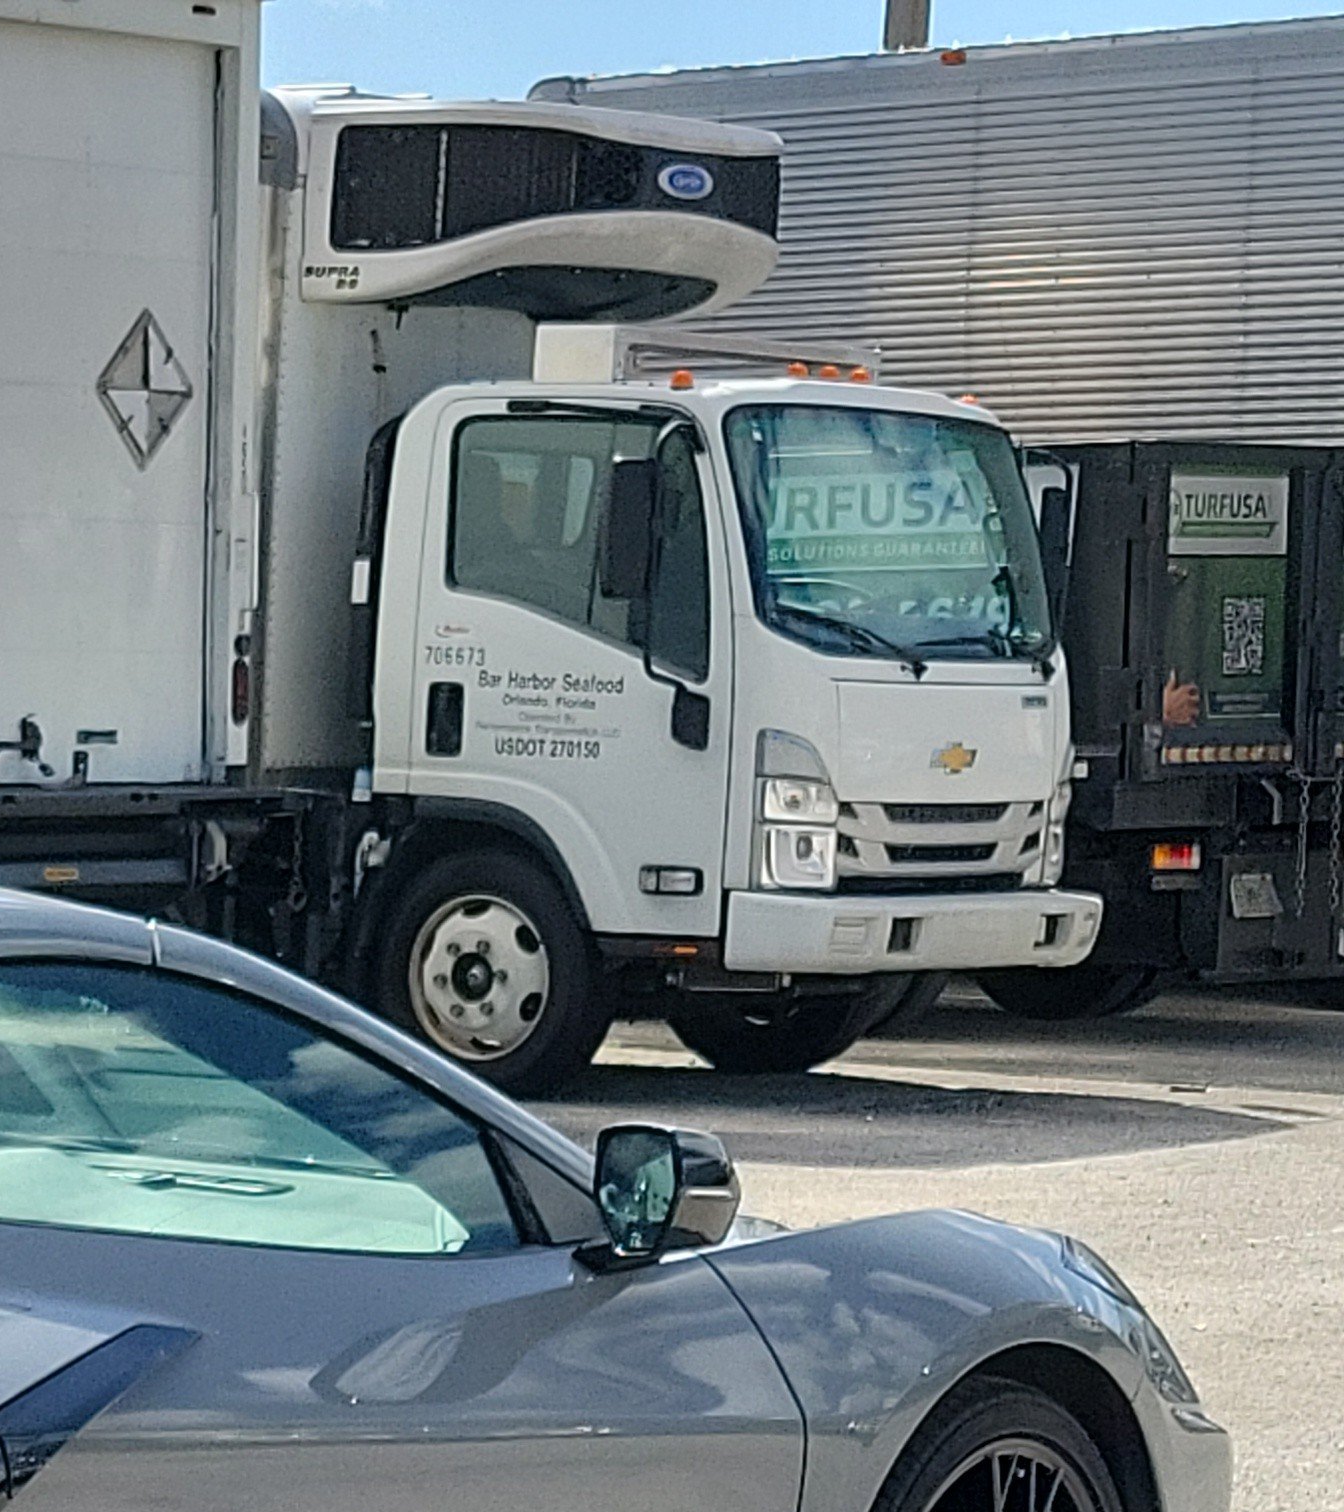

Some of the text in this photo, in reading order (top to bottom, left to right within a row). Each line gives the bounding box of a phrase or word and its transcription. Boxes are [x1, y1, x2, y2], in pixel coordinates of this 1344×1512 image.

[304, 266, 360, 278] SUPRA
[1184, 493, 1267, 519] TURFUSA
[478, 669, 625, 694] Bar Harbor Seafood
[556, 696, 596, 710] Florida
[494, 737, 601, 759] USDOT 270150
